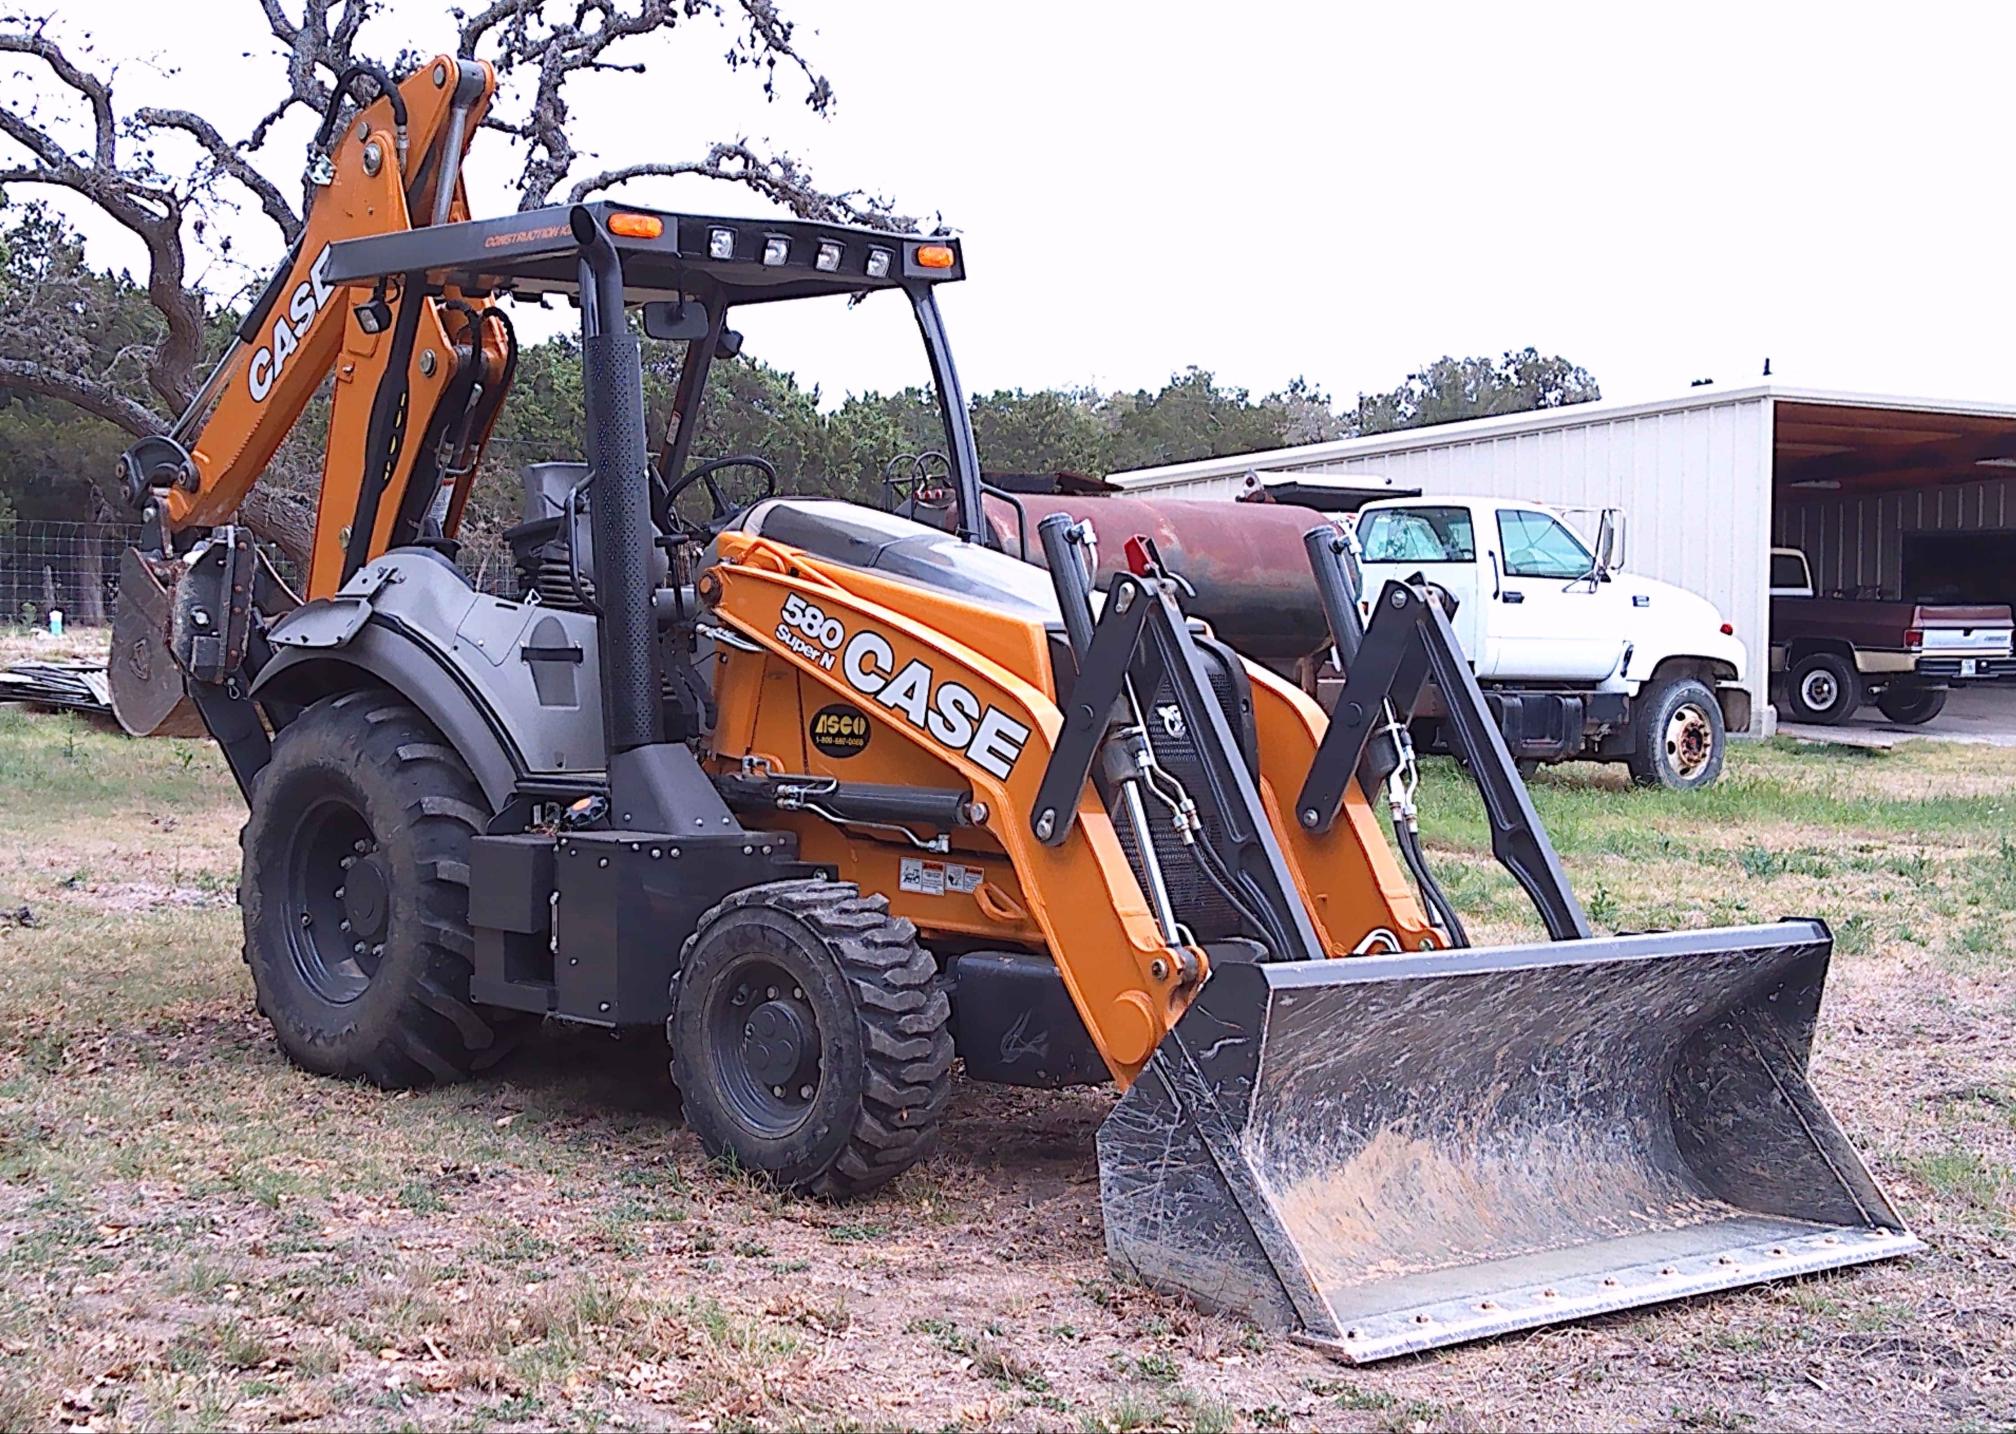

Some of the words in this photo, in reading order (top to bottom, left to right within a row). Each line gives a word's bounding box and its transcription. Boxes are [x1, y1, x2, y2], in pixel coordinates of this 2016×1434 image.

[484, 225, 561, 247] CONSTRUCTION
[248, 242, 336, 403] CASE
[775, 623, 821, 660] Super
[819, 650, 837, 672] N
[781, 592, 845, 650] 580
[815, 714, 866, 735] ASCO
[843, 630, 1032, 782] CASE
